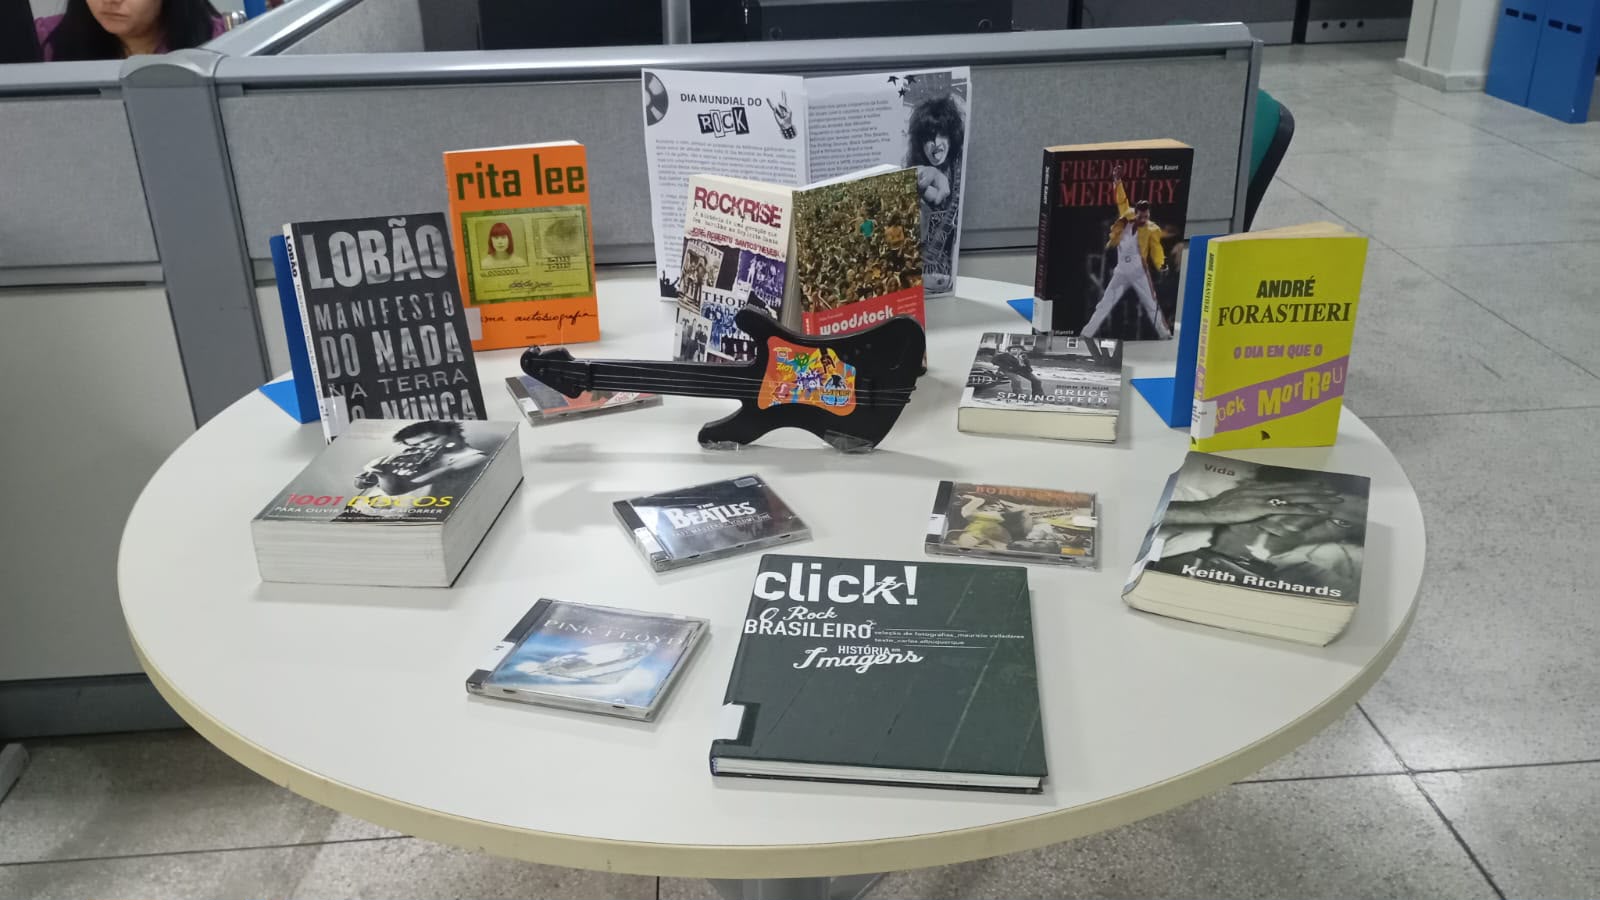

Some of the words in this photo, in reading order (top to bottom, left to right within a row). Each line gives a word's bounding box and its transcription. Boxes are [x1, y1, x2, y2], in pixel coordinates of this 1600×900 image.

[680, 93, 698, 103] DIA
[698, 94, 745, 106] MUNDIAL
[747, 97, 762, 107] DO
[698, 107, 749, 138] ROCK
[455, 161, 521, 200] rita
[533, 153, 586, 196] lee
[1060, 179, 1181, 206] MERURY
[694, 186, 783, 228] ROCKRISE
[285, 236, 298, 278] LOBÃO
[301, 217, 448, 290] LOBÃO
[1256, 276, 1316, 298] ANDRÉ
[313, 291, 455, 331] MANIFESTO
[820, 305, 894, 336] woodstock
[1217, 302, 1352, 327] FORASTIERI
[320, 333, 361, 380] DO
[371, 322, 465, 373] NADA
[1233, 346, 1242, 360] O
[1244, 345, 1264, 359] DIA
[1266, 345, 1285, 358] EM
[1287, 343, 1312, 360] QUE
[1314, 343, 1323, 357] O
[328, 383, 368, 399] NA
[377, 368, 468, 394] TERRA
[1054, 389, 1109, 397] BRUCE
[996, 391, 1108, 404] SPRINGSTEEN
[1203, 462, 1236, 477] Vida
[286, 493, 344, 508] 1001
[347, 495, 453, 507] DISCOS
[665, 501, 757, 530] BEATLES
[753, 562, 918, 606] click!
[1181, 564, 1236, 584] Keith
[1242, 574, 1343, 597] Richards
[782, 606, 838, 621] Rock
[544, 620, 593, 636] PINK
[605, 630, 683, 645] FLOYD
[743, 619, 873, 640] BRASILEIRO
[792, 647, 924, 674] Imagens
[838, 644, 891, 656] HISTÓRIA
